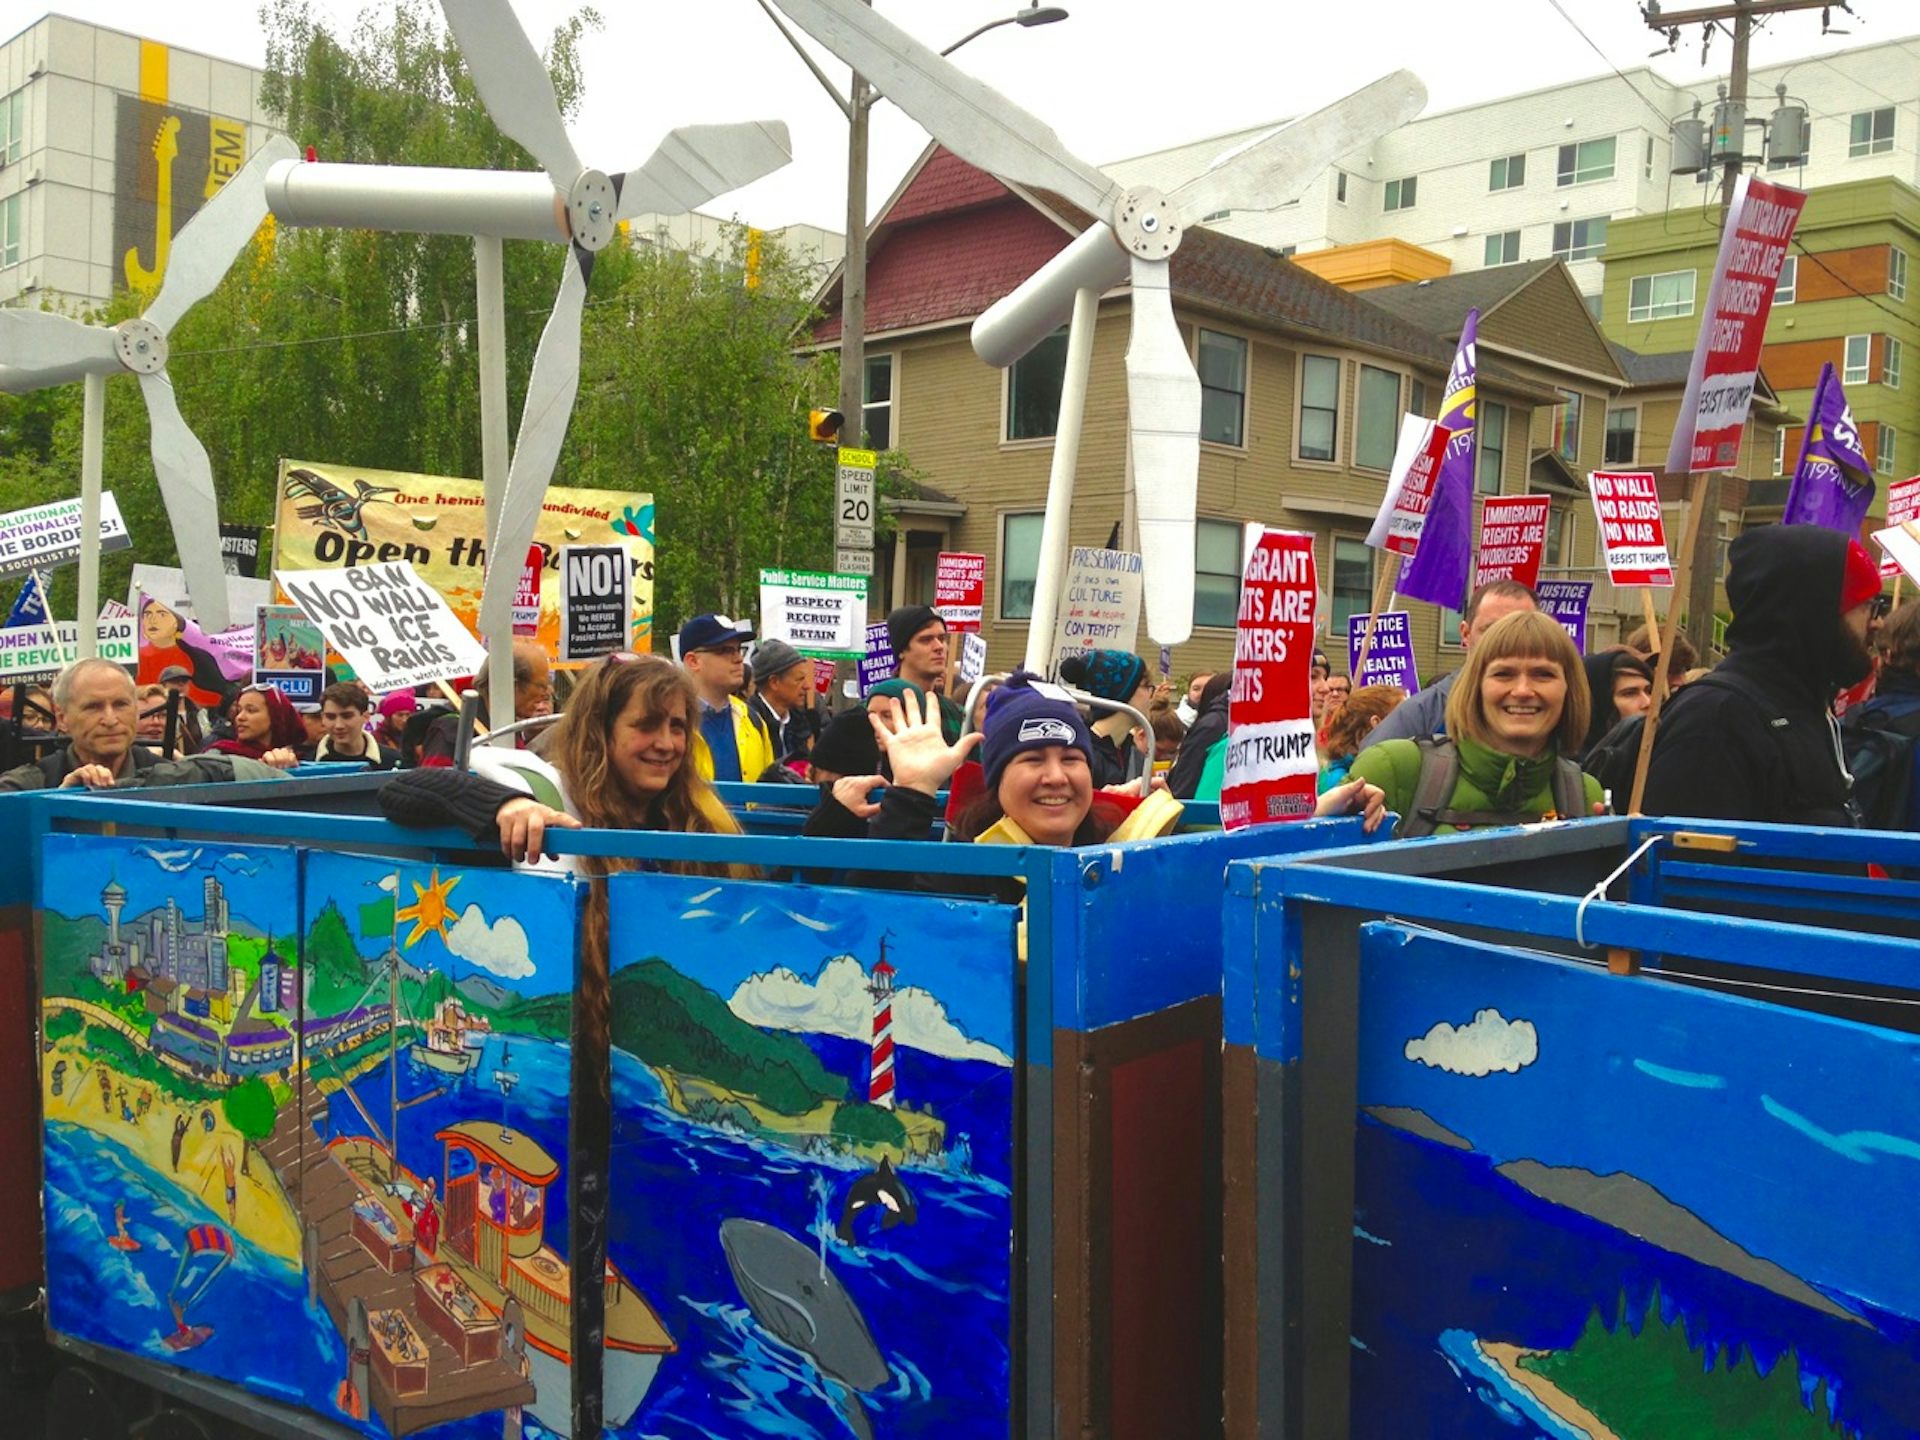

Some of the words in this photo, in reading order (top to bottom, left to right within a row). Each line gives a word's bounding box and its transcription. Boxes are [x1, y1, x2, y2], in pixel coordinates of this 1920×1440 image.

[1758, 245, 1786, 279] ARE
[1699, 388, 1726, 415] ESIST
[841, 451, 872, 465] SCHOOL
[841, 469, 873, 483] SPEED
[844, 482, 868, 495] LIMIT
[1595, 477, 1613, 497] NO
[1614, 479, 1654, 498] WALL
[394, 493, 430, 506] One
[435, 493, 486, 507] hemis
[542, 503, 611, 522] undivided
[842, 499, 870, 521] 20
[1484, 505, 1547, 525] IMMIGRANT
[1600, 499, 1617, 519] NO
[1619, 500, 1659, 520] RAIDS
[1481, 526, 1520, 546] RIGHTS
[1520, 525, 1543, 544] ARE
[1604, 521, 1623, 542] NO
[1622, 523, 1656, 543] WAR
[314, 530, 431, 569] Open
[446, 537, 487, 568] th
[840, 554, 849, 562] OR
[853, 555, 871, 563] WHEN
[1479, 547, 1534, 567] WORKERS'
[1610, 553, 1638, 565] RESIST
[1640, 552, 1667, 564] TRUMP
[7, 551, 64, 572] SOCIALIST
[840, 562, 871, 572] FLASHING
[940, 558, 984, 569] IMMIGRANT
[1072, 548, 1142, 574] PRESERVATION
[1246, 547, 1309, 584] GRANT
[346, 563, 411, 592] BAN
[569, 553, 622, 597] NO!
[760, 569, 790, 585] Public
[791, 573, 827, 588] Service
[828, 576, 867, 590] Matters
[938, 568, 967, 580] RIGHTS
[967, 569, 984, 580] ARE
[1475, 567, 1513, 587] RIGHTS
[938, 579, 977, 591] WORKERS'
[1538, 584, 1587, 599] JUSTICE
[287, 581, 361, 624] NO
[363, 586, 440, 616] WALL
[785, 595, 843, 609] RESPECT
[936, 590, 965, 601] RIGHTS
[1069, 586, 1122, 604] CULTURE
[960, 608, 980, 617] TRUMP
[1269, 589, 1313, 623] ARE
[1540, 600, 1554, 614] OR
[1556, 601, 1581, 615] ALL
[578, 614, 589, 622] We
[590, 612, 615, 622] REFUSE
[786, 611, 841, 624] RECRUIT
[1353, 616, 1404, 634] JUTICE
[96, 625, 132, 640] EAD
[389, 613, 440, 643] ICE
[570, 633, 596, 642] Fascist
[597, 631, 623, 641] America
[578, 624, 586, 632] to
[587, 624, 610, 632] Accept
[790, 627, 836, 640] RETAIN
[1064, 620, 1121, 638] CONTEMPT
[878, 638, 892, 651] AL
[1353, 635, 1378, 651] FR
[1382, 634, 1406, 650] ALL
[17, 641, 133, 666] REVOLION
[370, 639, 457, 674] Raids
[861, 655, 895, 672] HEALTH
[369, 675, 410, 691] Workers
[412, 668, 443, 682] World
[446, 664, 472, 676] Party
[867, 667, 892, 682] CARE
[1367, 672, 1403, 687] CARE
[1254, 731, 1312, 764] TRUMP
